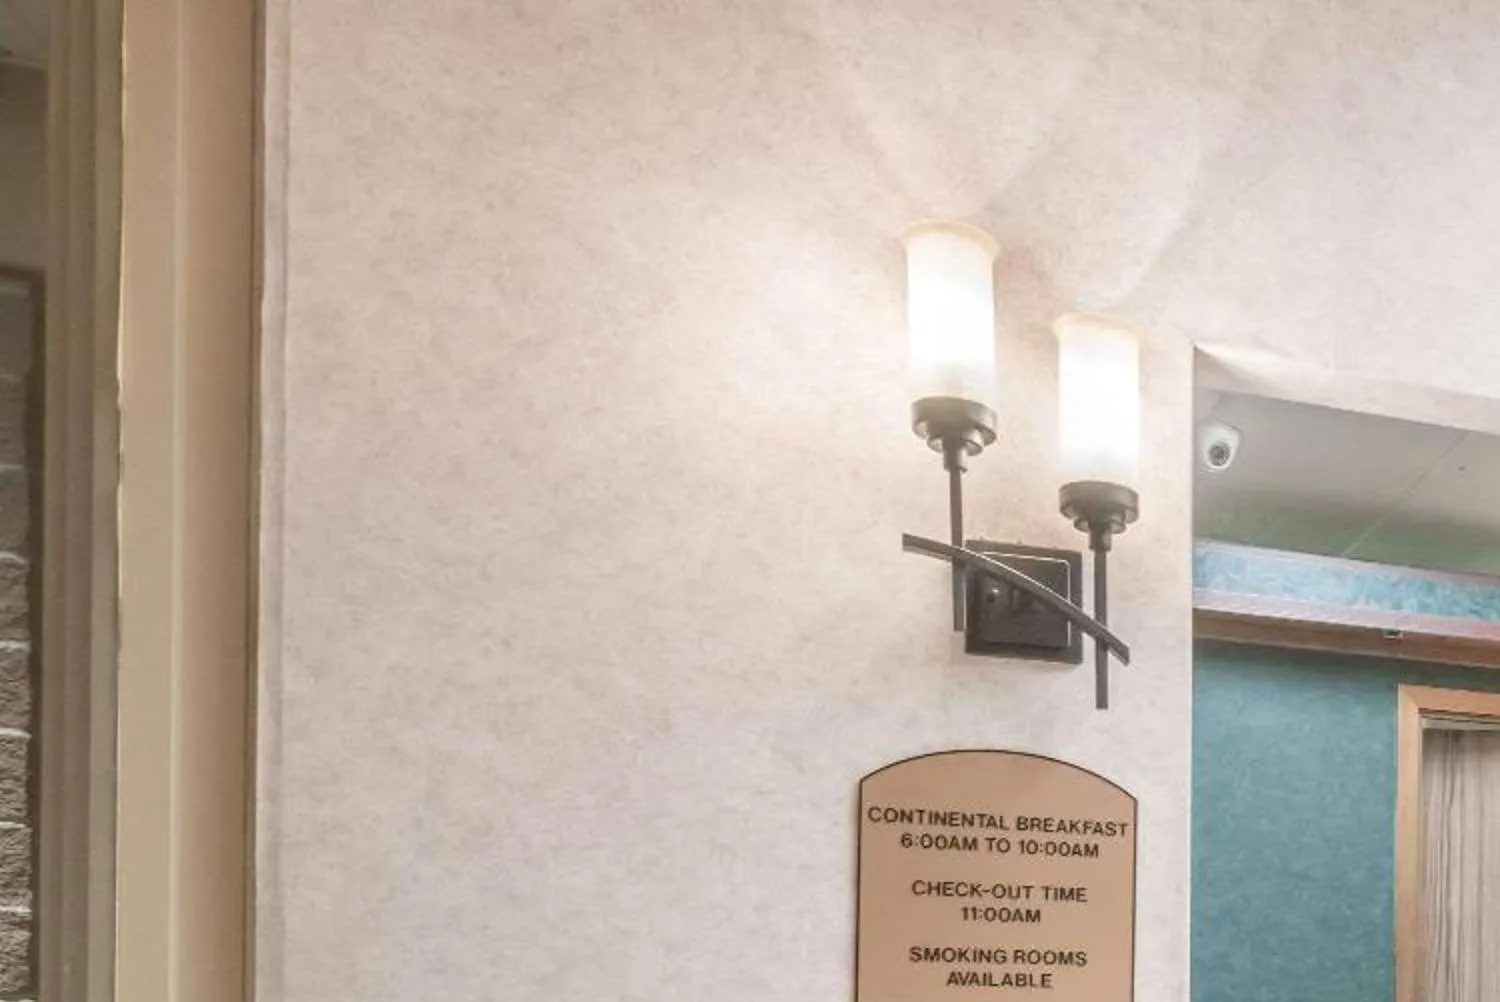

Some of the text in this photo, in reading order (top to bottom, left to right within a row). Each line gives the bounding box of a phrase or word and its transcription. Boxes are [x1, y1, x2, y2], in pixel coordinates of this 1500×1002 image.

[868, 807, 1128, 837] CONTINENTAL BREAKFAST
[901, 834, 1099, 858] 6:00AM TO 10:00AM
[911, 880, 1088, 902] CHECK-OUT TIME
[961, 907, 1041, 923] 11:00AM
[909, 946, 1088, 967] SMOKING ROOMS
[946, 972, 1053, 988] AVAILABLE
